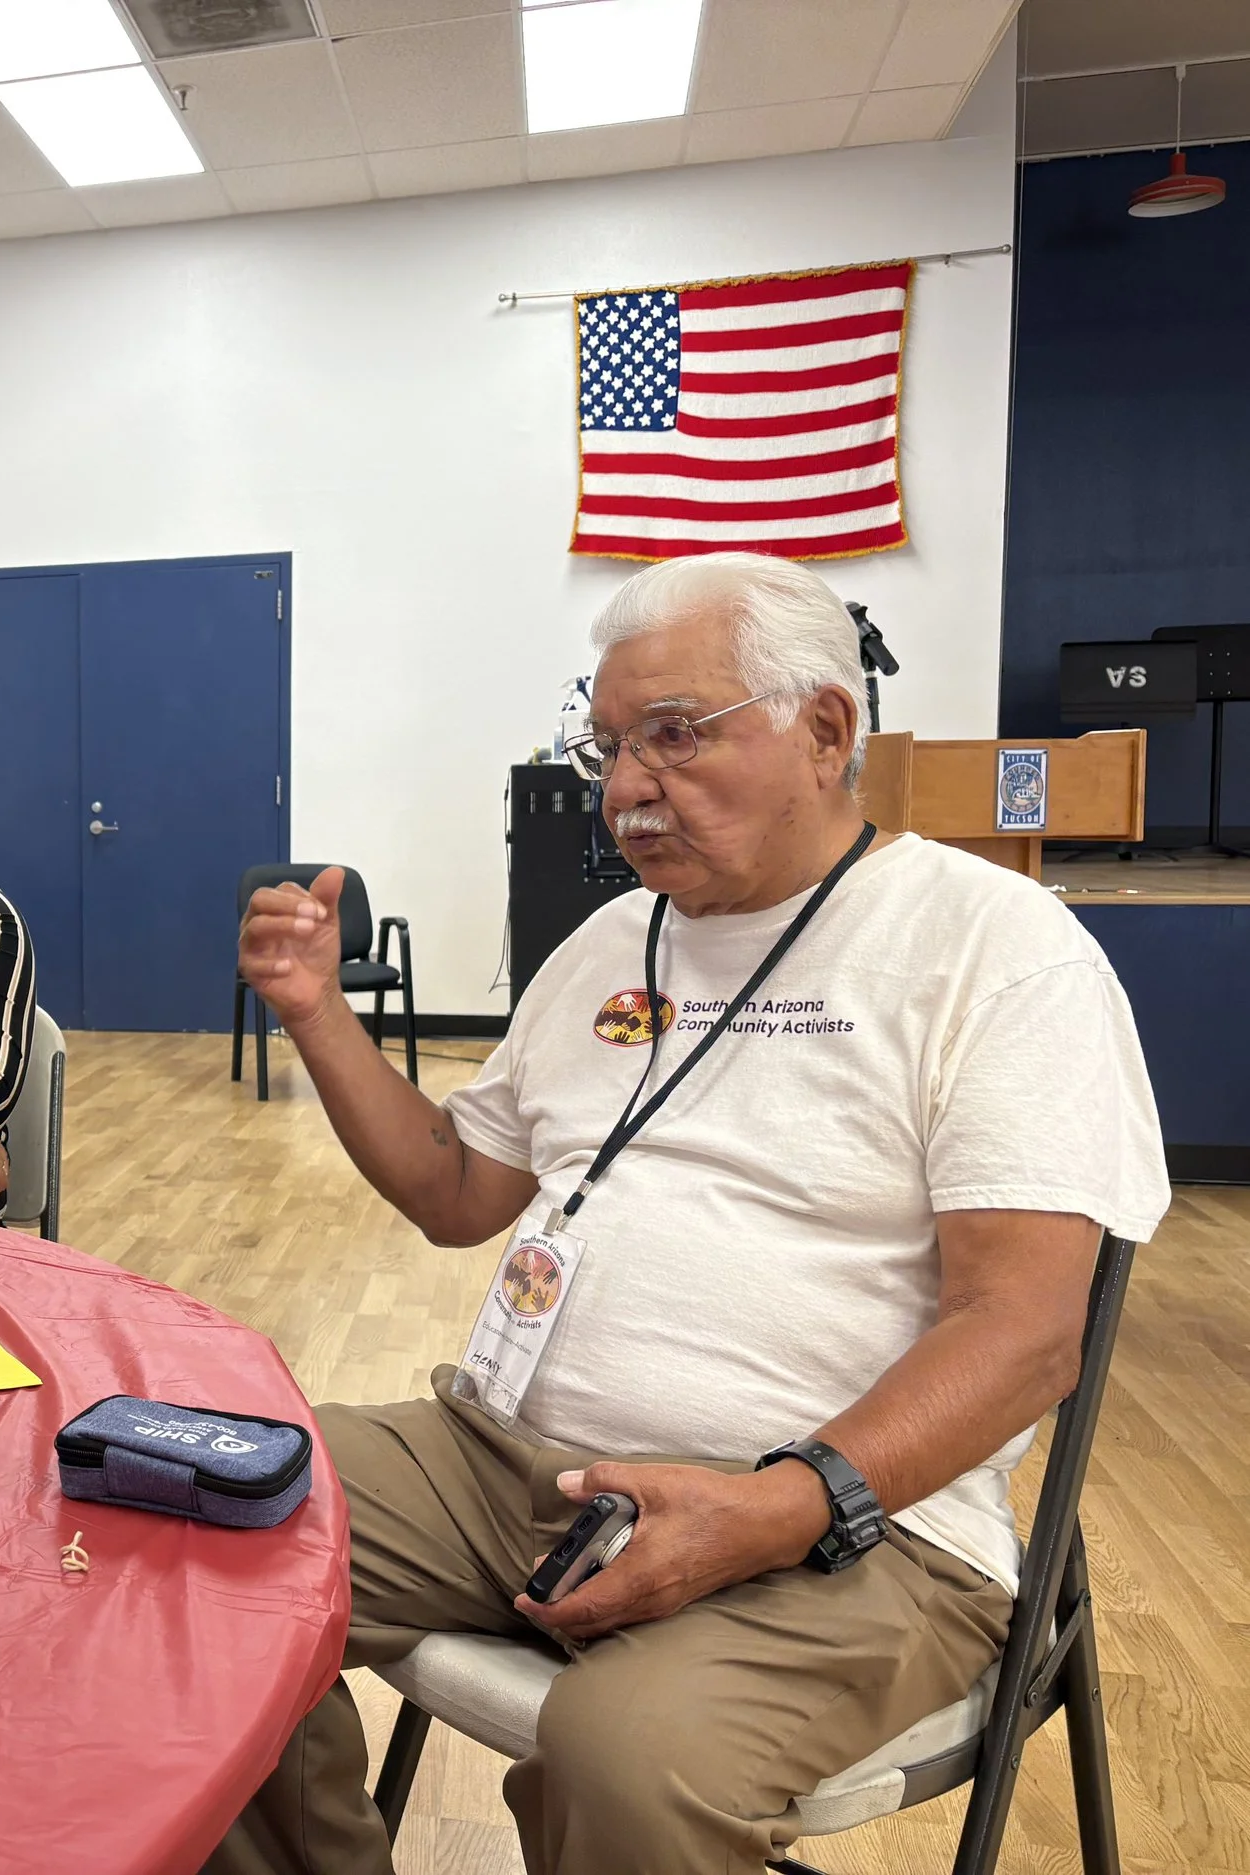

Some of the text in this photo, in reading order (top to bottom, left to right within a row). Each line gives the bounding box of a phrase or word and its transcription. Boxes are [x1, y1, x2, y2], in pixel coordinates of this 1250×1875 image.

[1006, 755, 1026, 763] CITY
[1005, 814, 1039, 823] TUCSON
[682, 999, 825, 1014] Southn Arizona
[781, 1017, 855, 1034] Activists
[519, 1234, 566, 1268] Southern Arizona
[516, 1318, 542, 1330] Activists
[134, 1426, 201, 1444] SHIP
